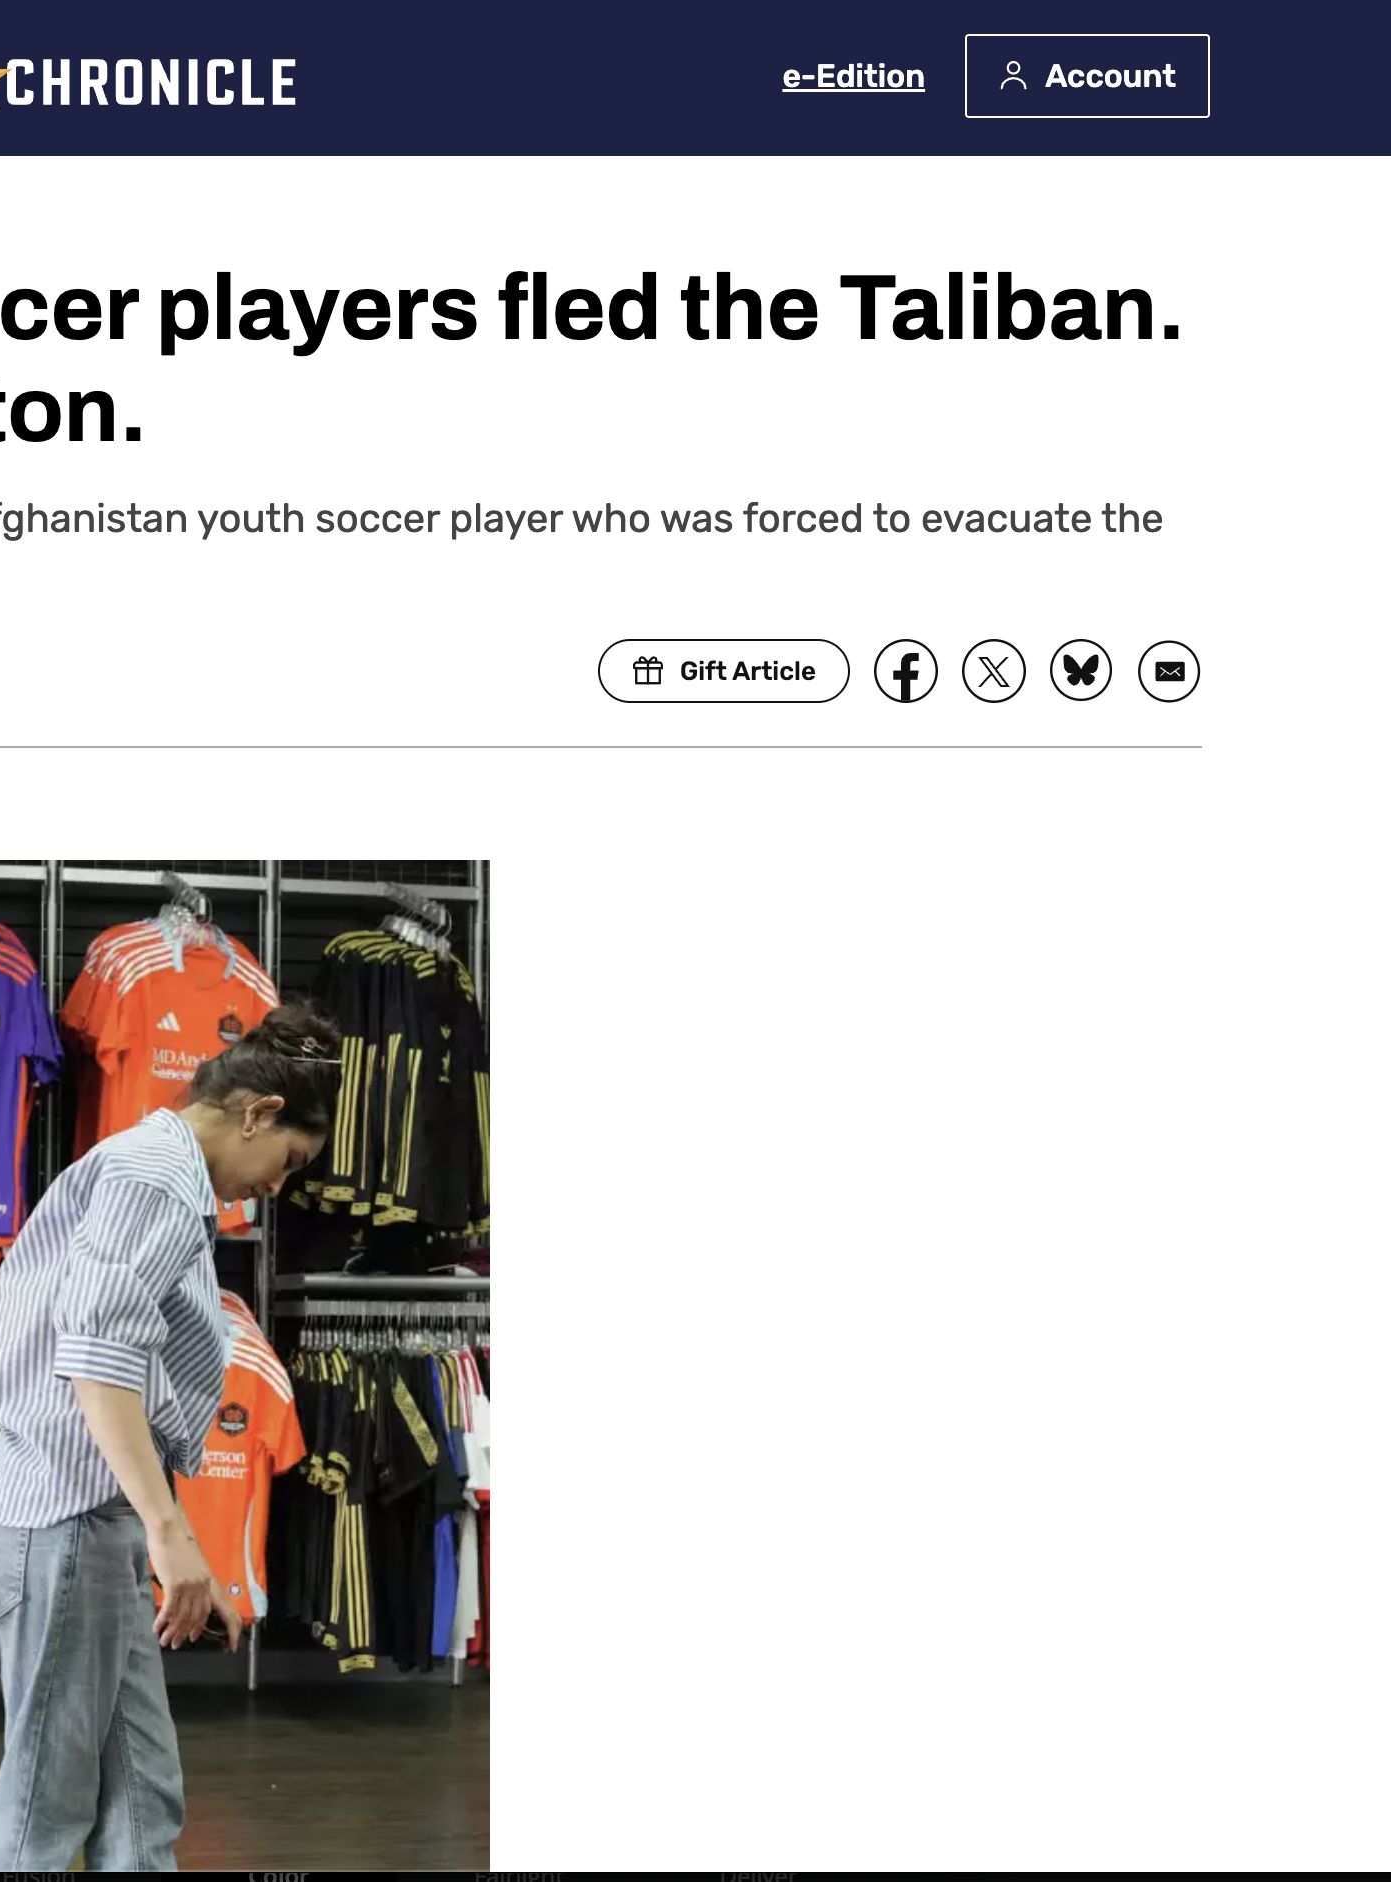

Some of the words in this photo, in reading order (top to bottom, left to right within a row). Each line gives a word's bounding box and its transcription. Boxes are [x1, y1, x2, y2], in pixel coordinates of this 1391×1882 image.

[7, 59, 296, 105] CHRONICLE
[782, 63, 925, 90] e-Edition
[1045, 64, 1176, 88] Account
[161, 272, 477, 357] players
[498, 271, 656, 340] fled
[681, 271, 818, 340] the
[840, 271, 1179, 340] Taliban.
[198, 503, 303, 540] youth
[316, 510, 441, 533] soccer
[452, 503, 564, 540] player
[572, 503, 649, 533] who
[661, 510, 732, 533] was
[743, 503, 861, 533] forced
[873, 503, 910, 533] to
[922, 503, 1091, 533] evacuate
[1101, 503, 1162, 533] the
[681, 660, 728, 682] Gift
[732, 660, 816, 682] Article
[152, 1048, 177, 1065] MD
